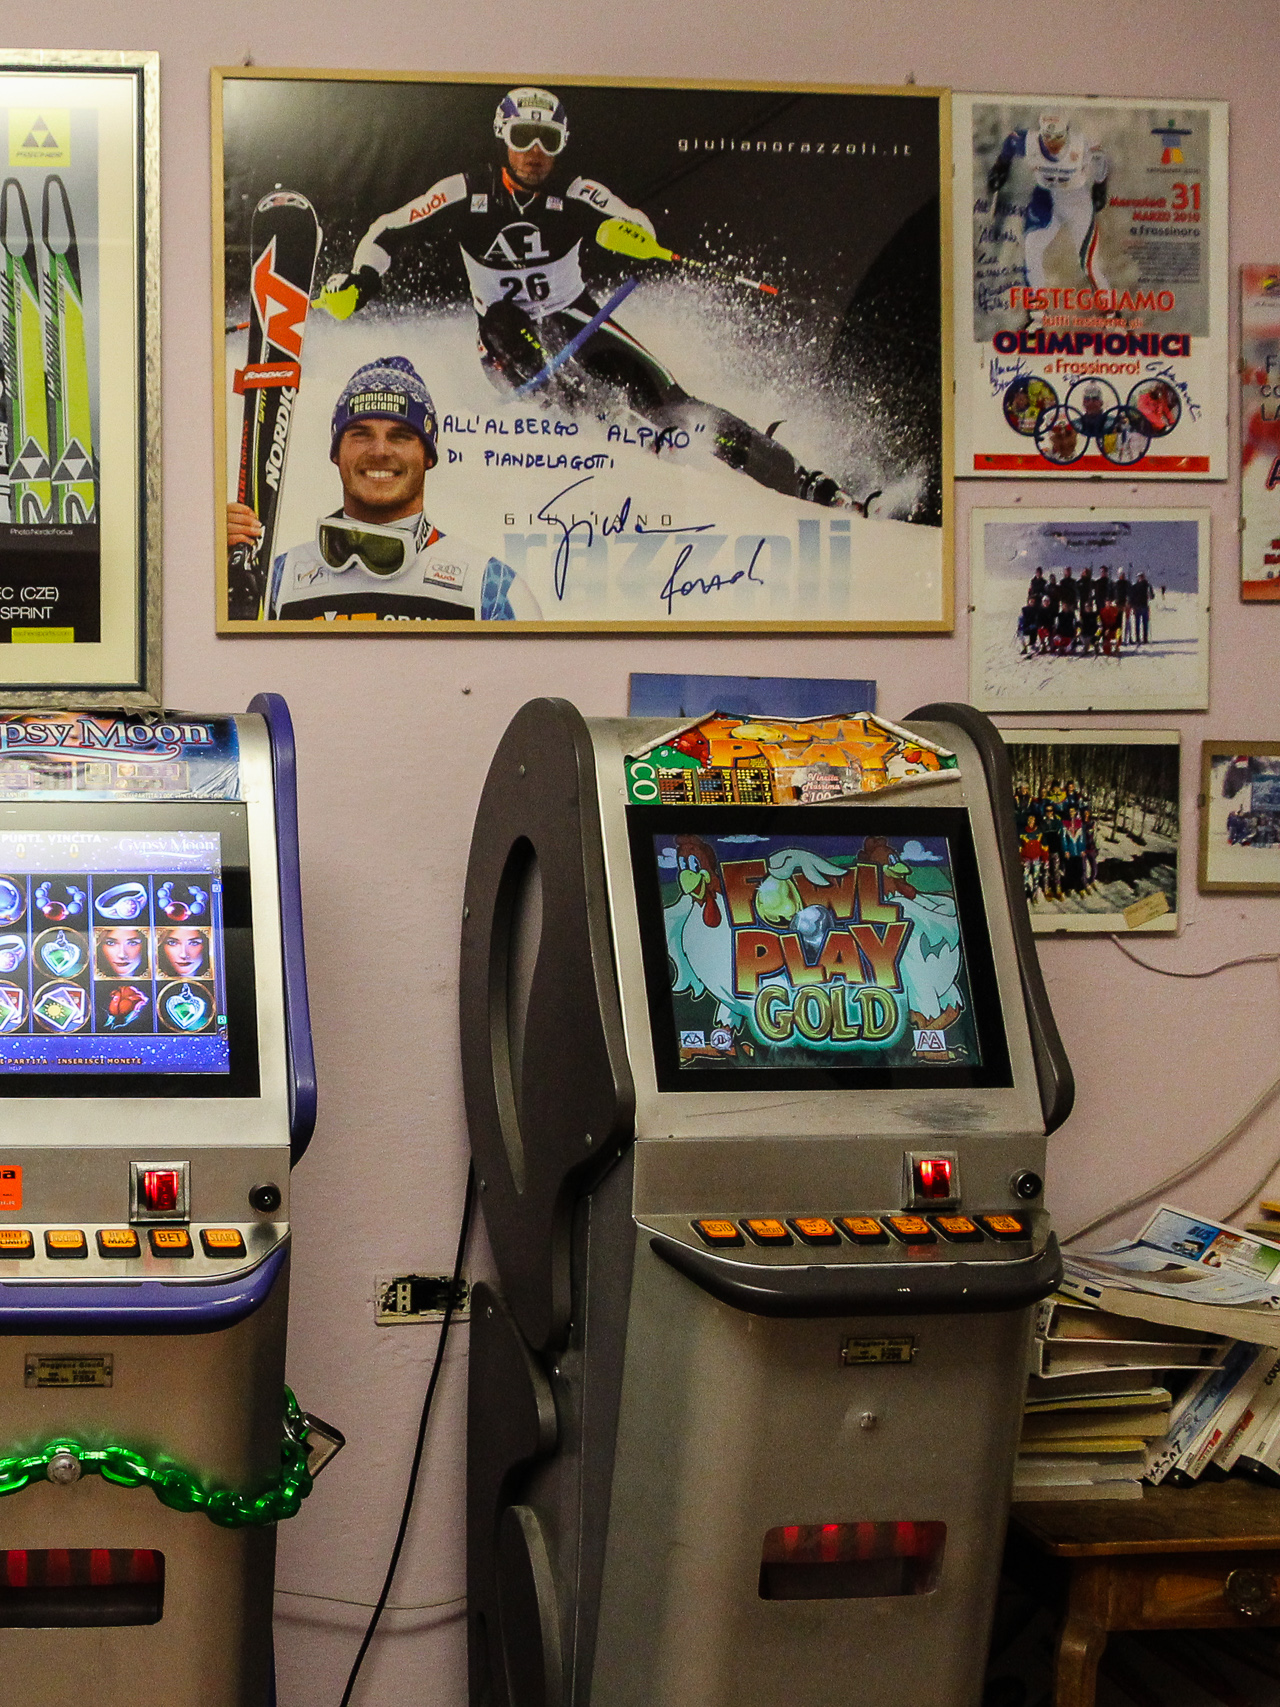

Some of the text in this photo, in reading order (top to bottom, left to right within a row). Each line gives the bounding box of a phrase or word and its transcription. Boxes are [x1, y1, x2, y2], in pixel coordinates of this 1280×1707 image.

[678, 138, 912, 156] giulianorazzoli.it
[1171, 181, 1202, 210] 31
[408, 192, 448, 223] Audi
[1132, 210, 1201, 223] MARZO 2010
[499, 272, 551, 302] 26
[1008, 287, 1176, 312] FESTEGGIAMO
[1042, 315, 1070, 327] tutti
[992, 330, 1192, 357] OLIMPIONICI
[1044, 359, 1141, 377] a Frassinoro!
[349, 391, 407, 404] PARMIGIANO
[353, 402, 401, 413] REGGIANO
[447, 449, 615, 470] DI PIANDELAGOTTI
[503, 518, 852, 620] razzoli
[19, 586, 60, 602] (CZE)
[0, 606, 54, 620] SPRINT
[80, 718, 214, 749] Moon
[48, 834, 102, 844] VINCITA
[118, 838, 215, 855] Gypsy Moon
[15, 843, 26, 858] 0
[69, 843, 80, 858] 0
[732, 920, 912, 998] PLAY
[754, 984, 901, 1042] GOLD
[158, 1232, 182, 1243] BET
[207, 1232, 238, 1242] START
[1186, 1226, 1216, 1240] BUS
